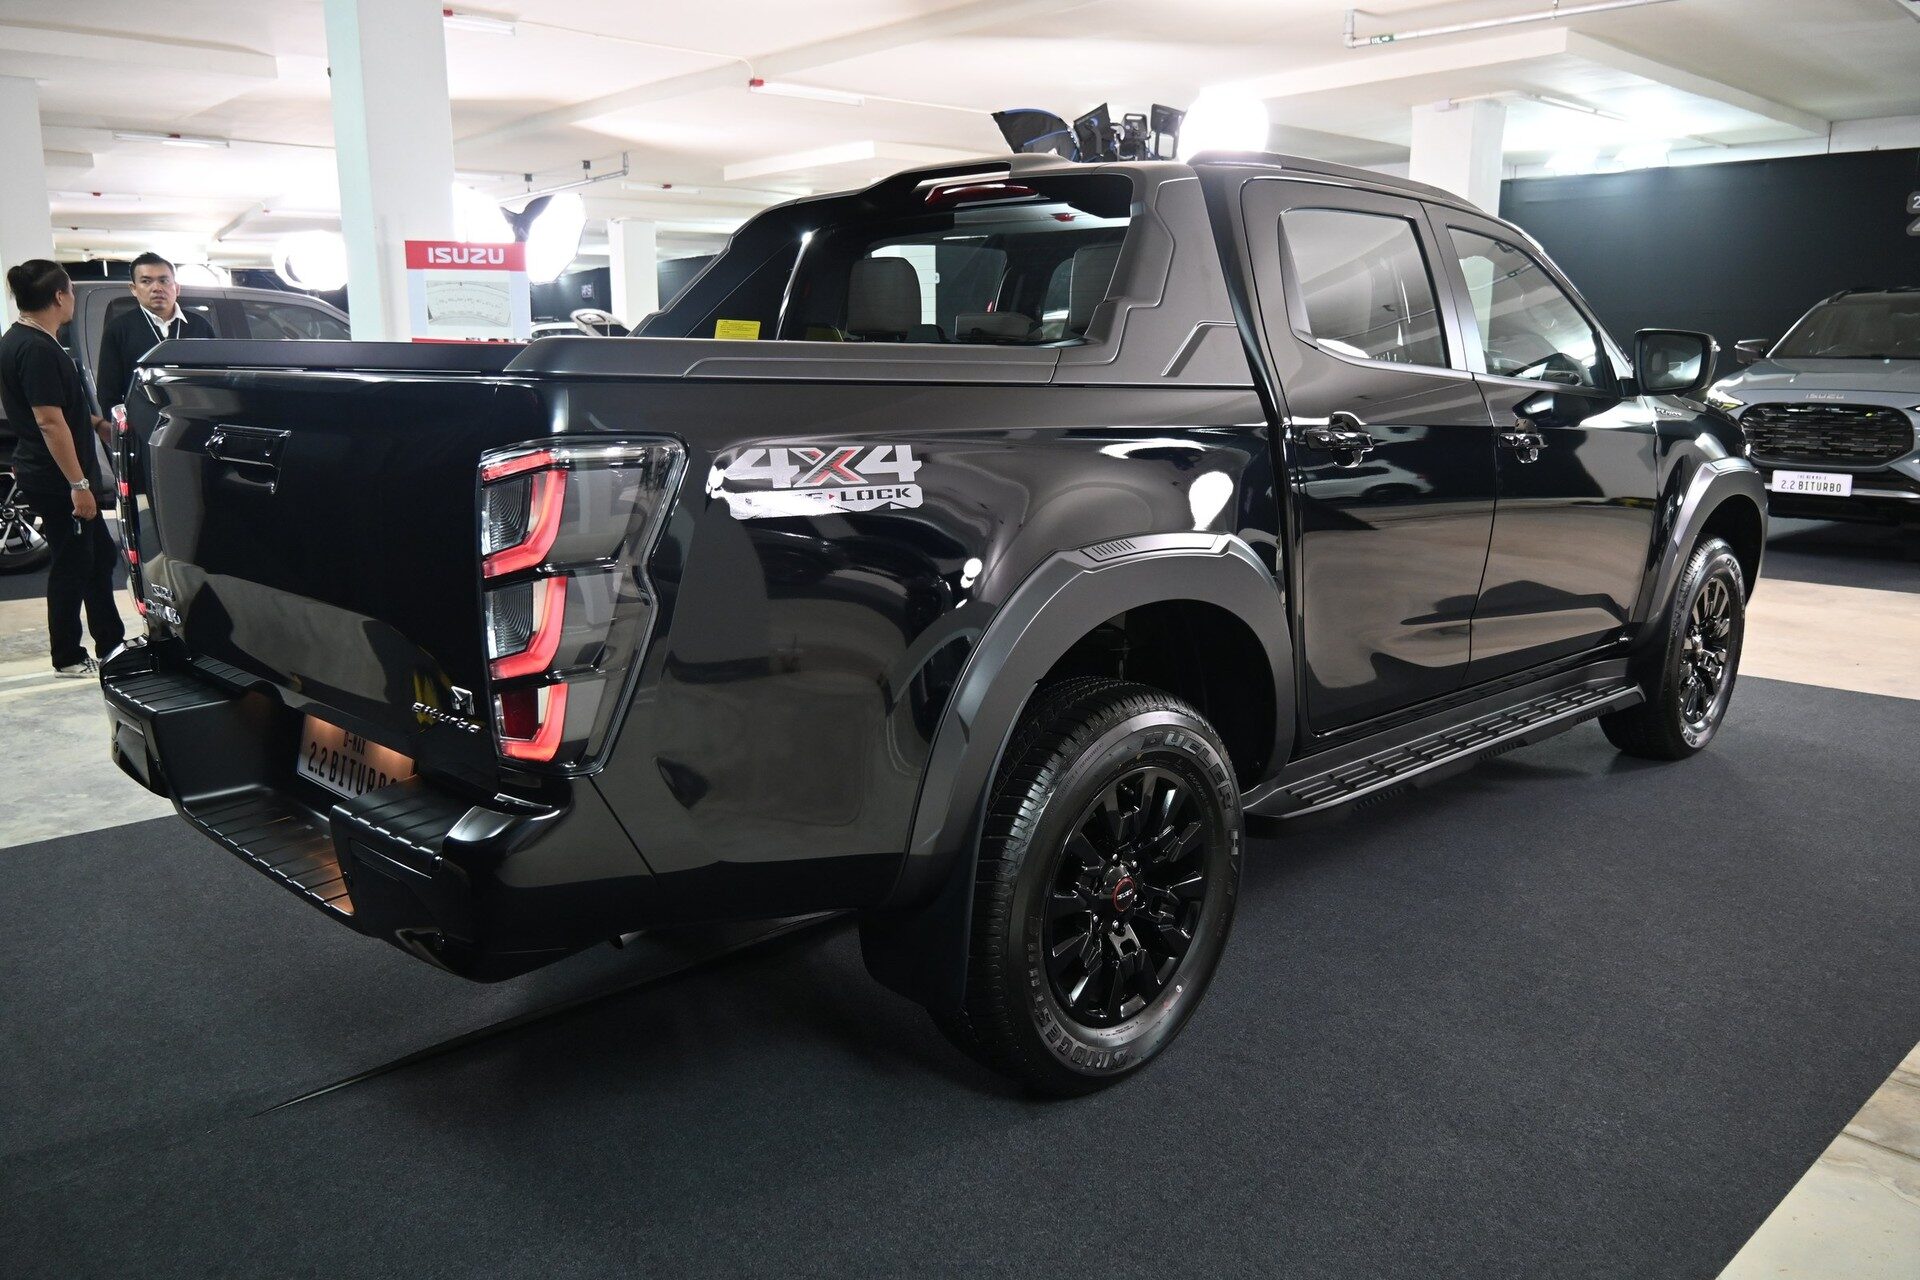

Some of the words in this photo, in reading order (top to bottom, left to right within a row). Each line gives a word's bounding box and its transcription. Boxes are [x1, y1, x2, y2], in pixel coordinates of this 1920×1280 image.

[427, 247, 505, 264] ISUZU
[840, 487, 912, 502] LOCK
[1781, 480, 1796, 490] 2.2
[1798, 481, 1842, 493] BITURBO
[307, 741, 328, 778] 2.2
[329, 750, 397, 796] BITUR
[1141, 731, 1234, 810] DUELER
